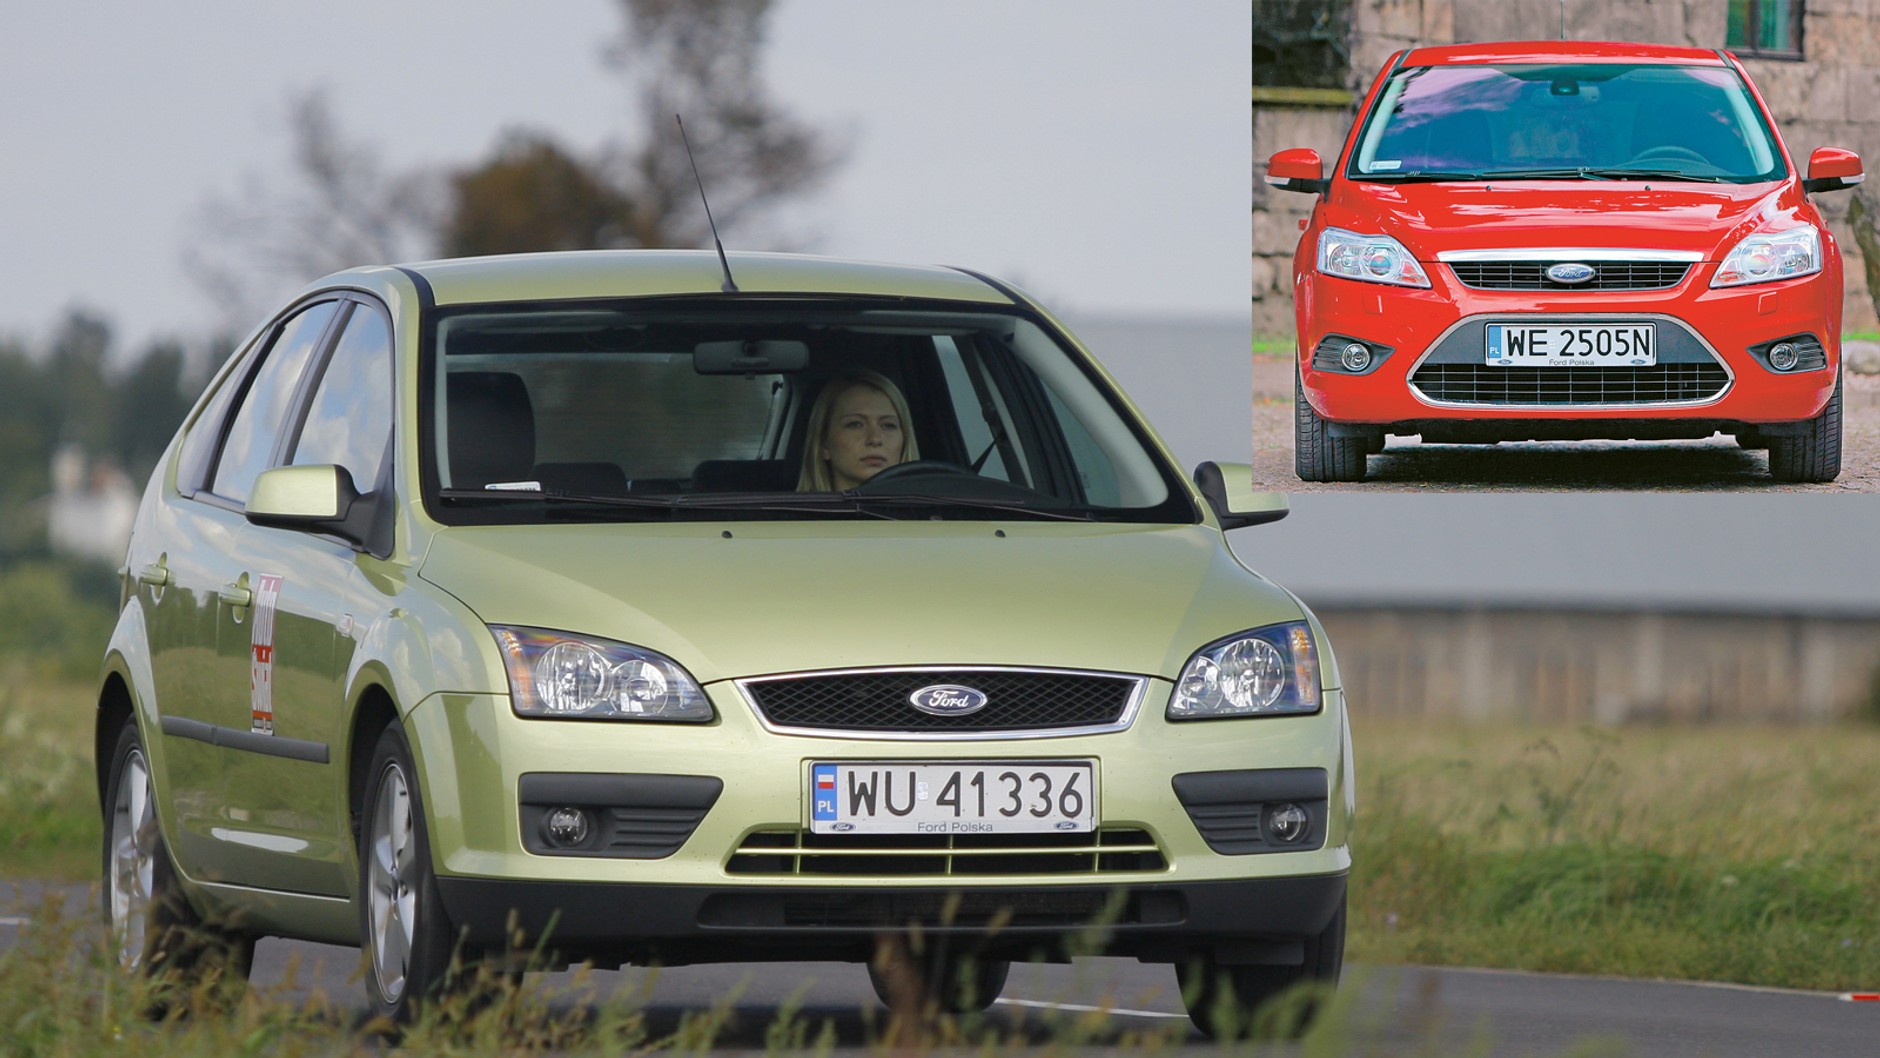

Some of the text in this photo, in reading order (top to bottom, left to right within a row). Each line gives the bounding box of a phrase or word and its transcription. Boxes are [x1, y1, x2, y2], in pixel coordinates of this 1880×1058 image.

[1506, 329, 1650, 357] WE 2505N
[1489, 346, 1500, 354] PL
[1548, 358, 1595, 366] Ford Polska
[928, 690, 969, 707] Ford
[848, 771, 1083, 818] WU 41336
[817, 801, 834, 813] PL
[917, 821, 993, 833] Ford Polska
